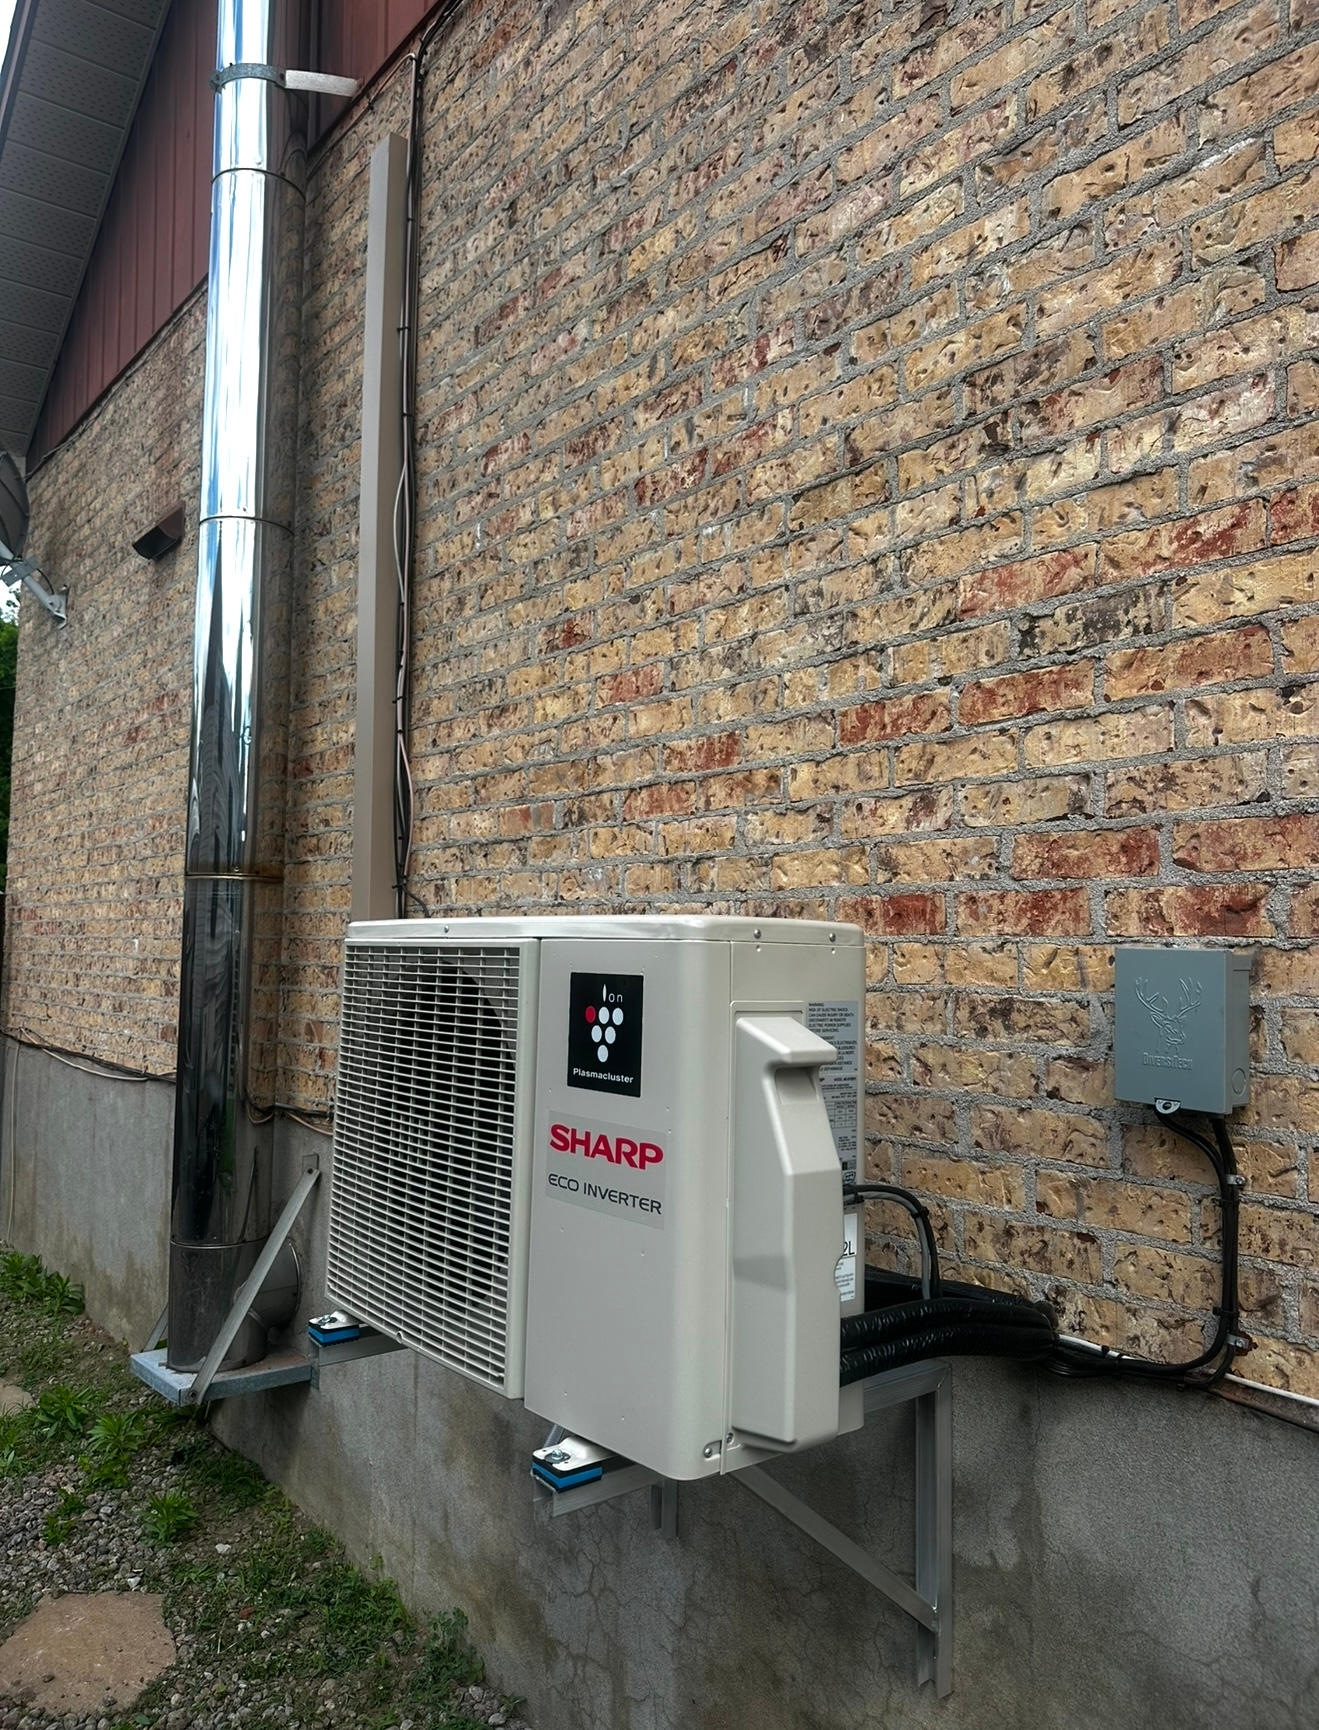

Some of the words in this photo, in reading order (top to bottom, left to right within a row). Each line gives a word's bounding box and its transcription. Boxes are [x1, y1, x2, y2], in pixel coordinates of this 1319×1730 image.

[602, 983, 623, 1003] Ion
[573, 1067, 634, 1084] Plasmacluster
[549, 1123, 664, 1170] SHARP
[548, 1172, 580, 1192] ECO
[583, 1182, 662, 1215] INVERTER
